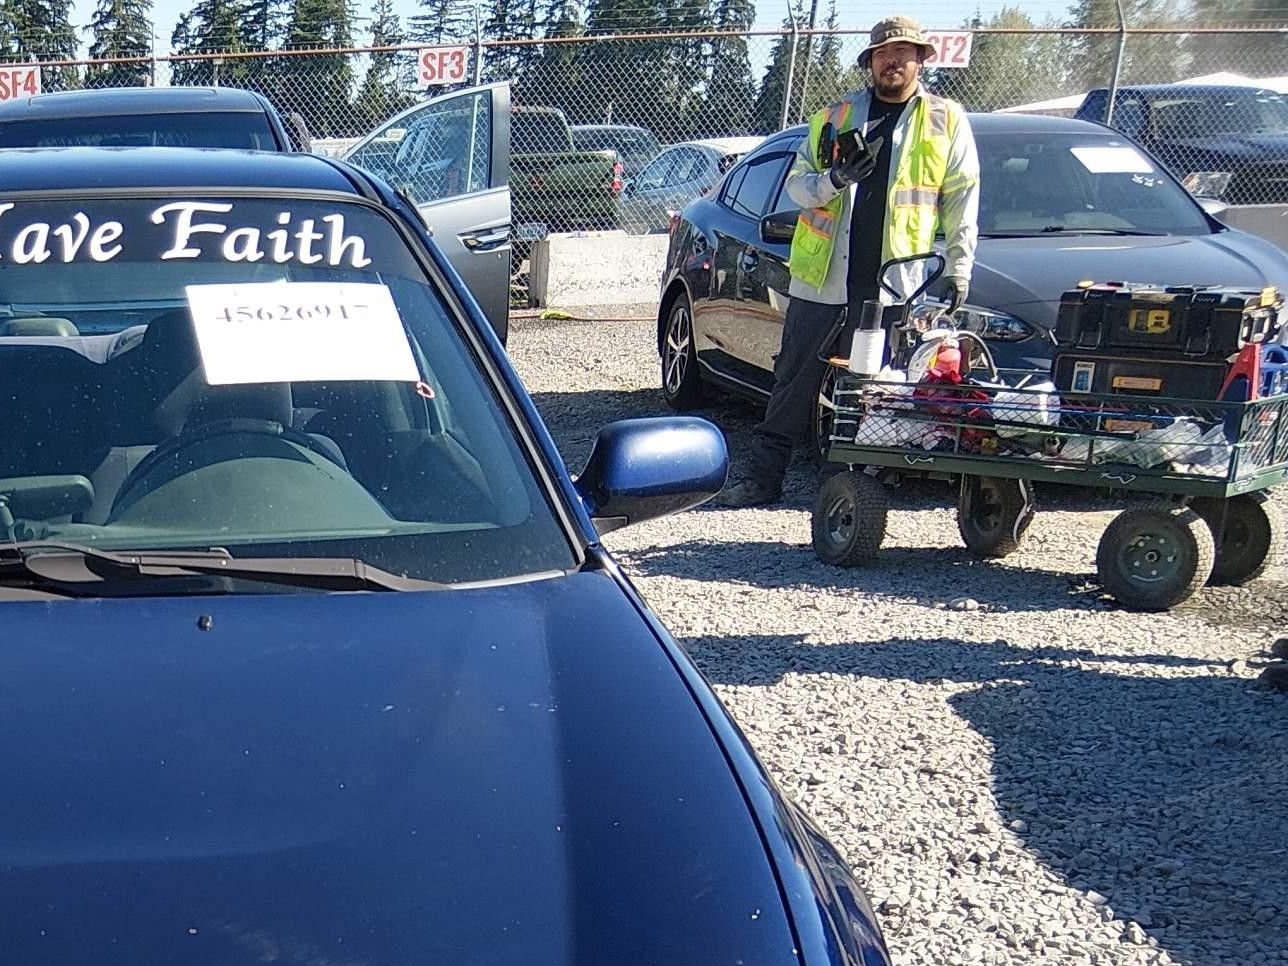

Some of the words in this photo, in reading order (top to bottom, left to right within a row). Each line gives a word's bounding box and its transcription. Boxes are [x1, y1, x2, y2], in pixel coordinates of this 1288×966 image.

[926, 35, 967, 63] SF2
[422, 50, 464, 80] SF3
[150, 201, 372, 268] Faith
